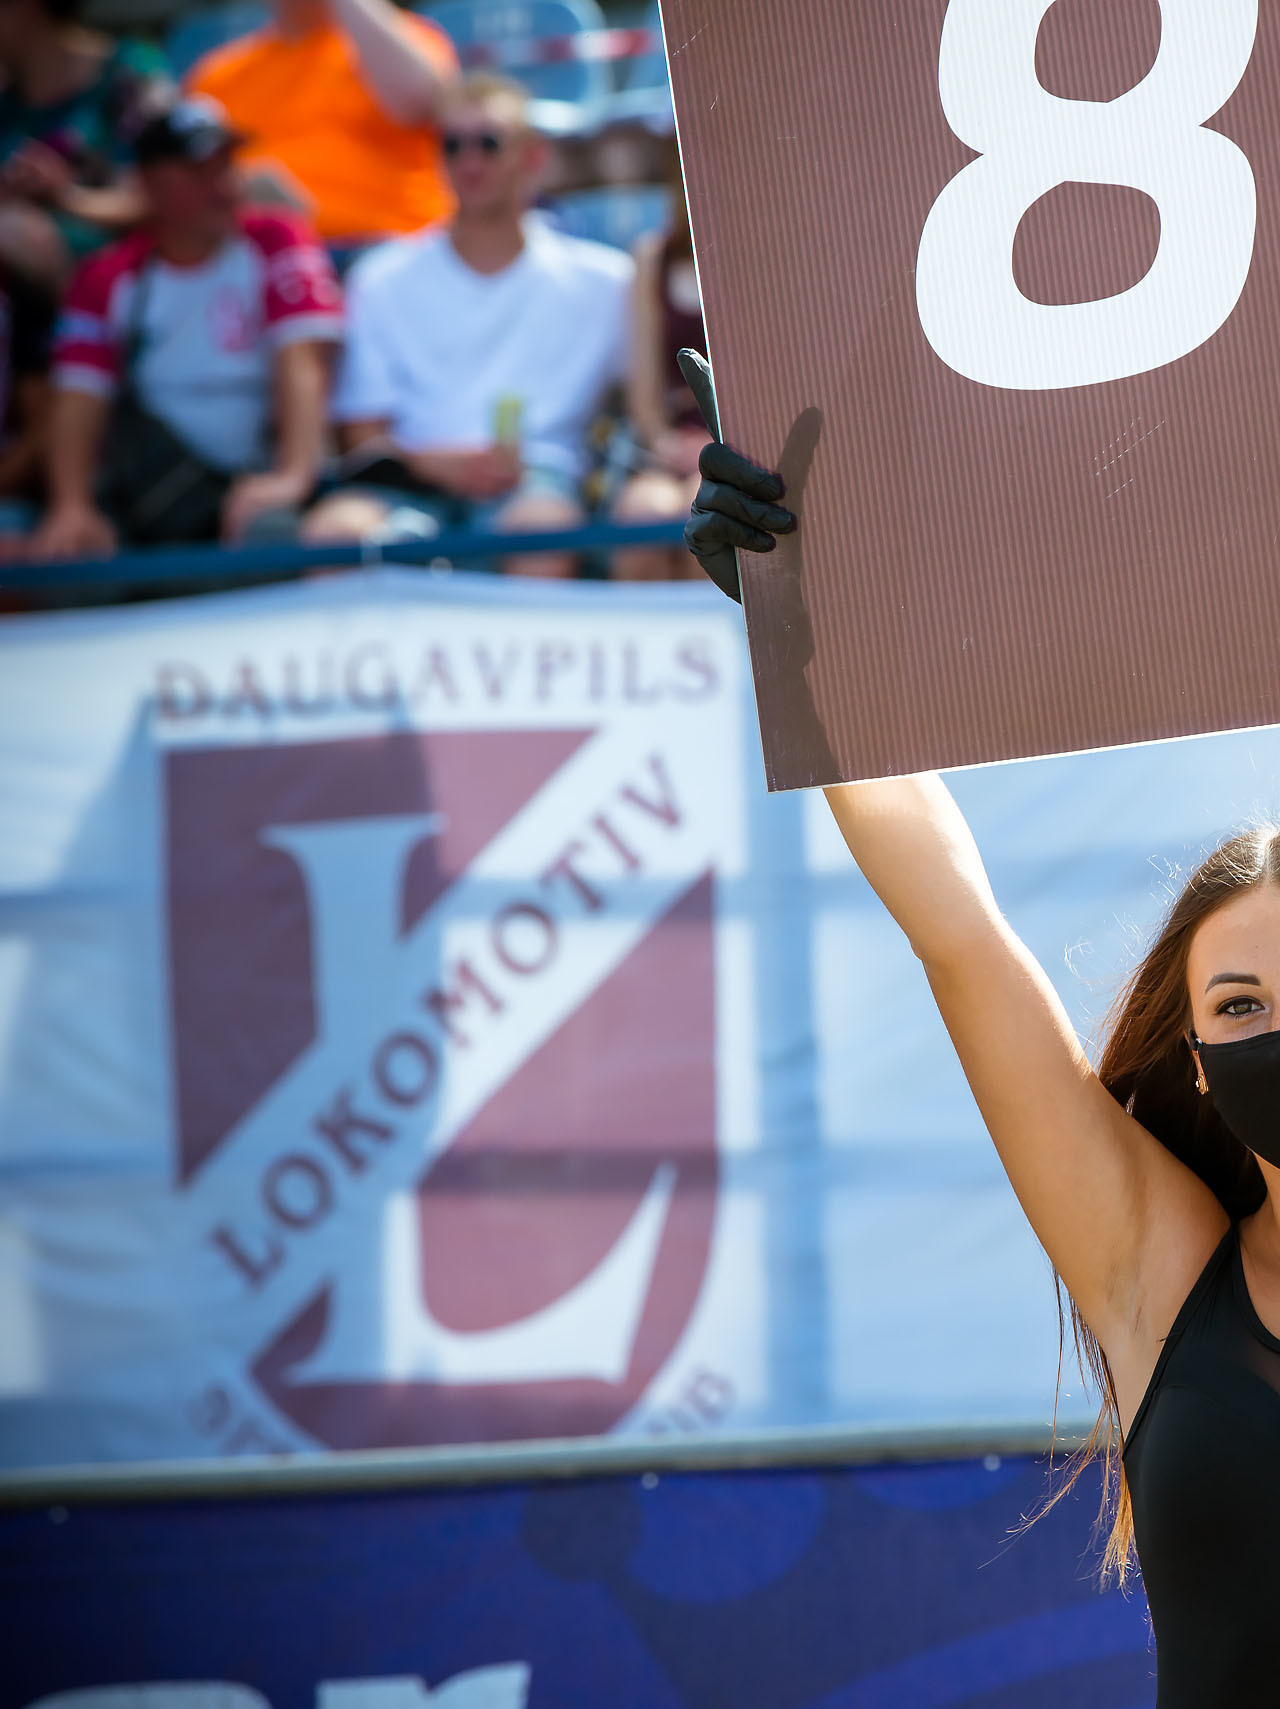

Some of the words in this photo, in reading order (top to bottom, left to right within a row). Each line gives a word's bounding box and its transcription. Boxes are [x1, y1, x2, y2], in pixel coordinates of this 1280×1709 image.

[915, 0, 1259, 390] 8
[154, 633, 721, 722] DAUGAVPILS
[208, 750, 685, 1289] LOKOMOTIV
